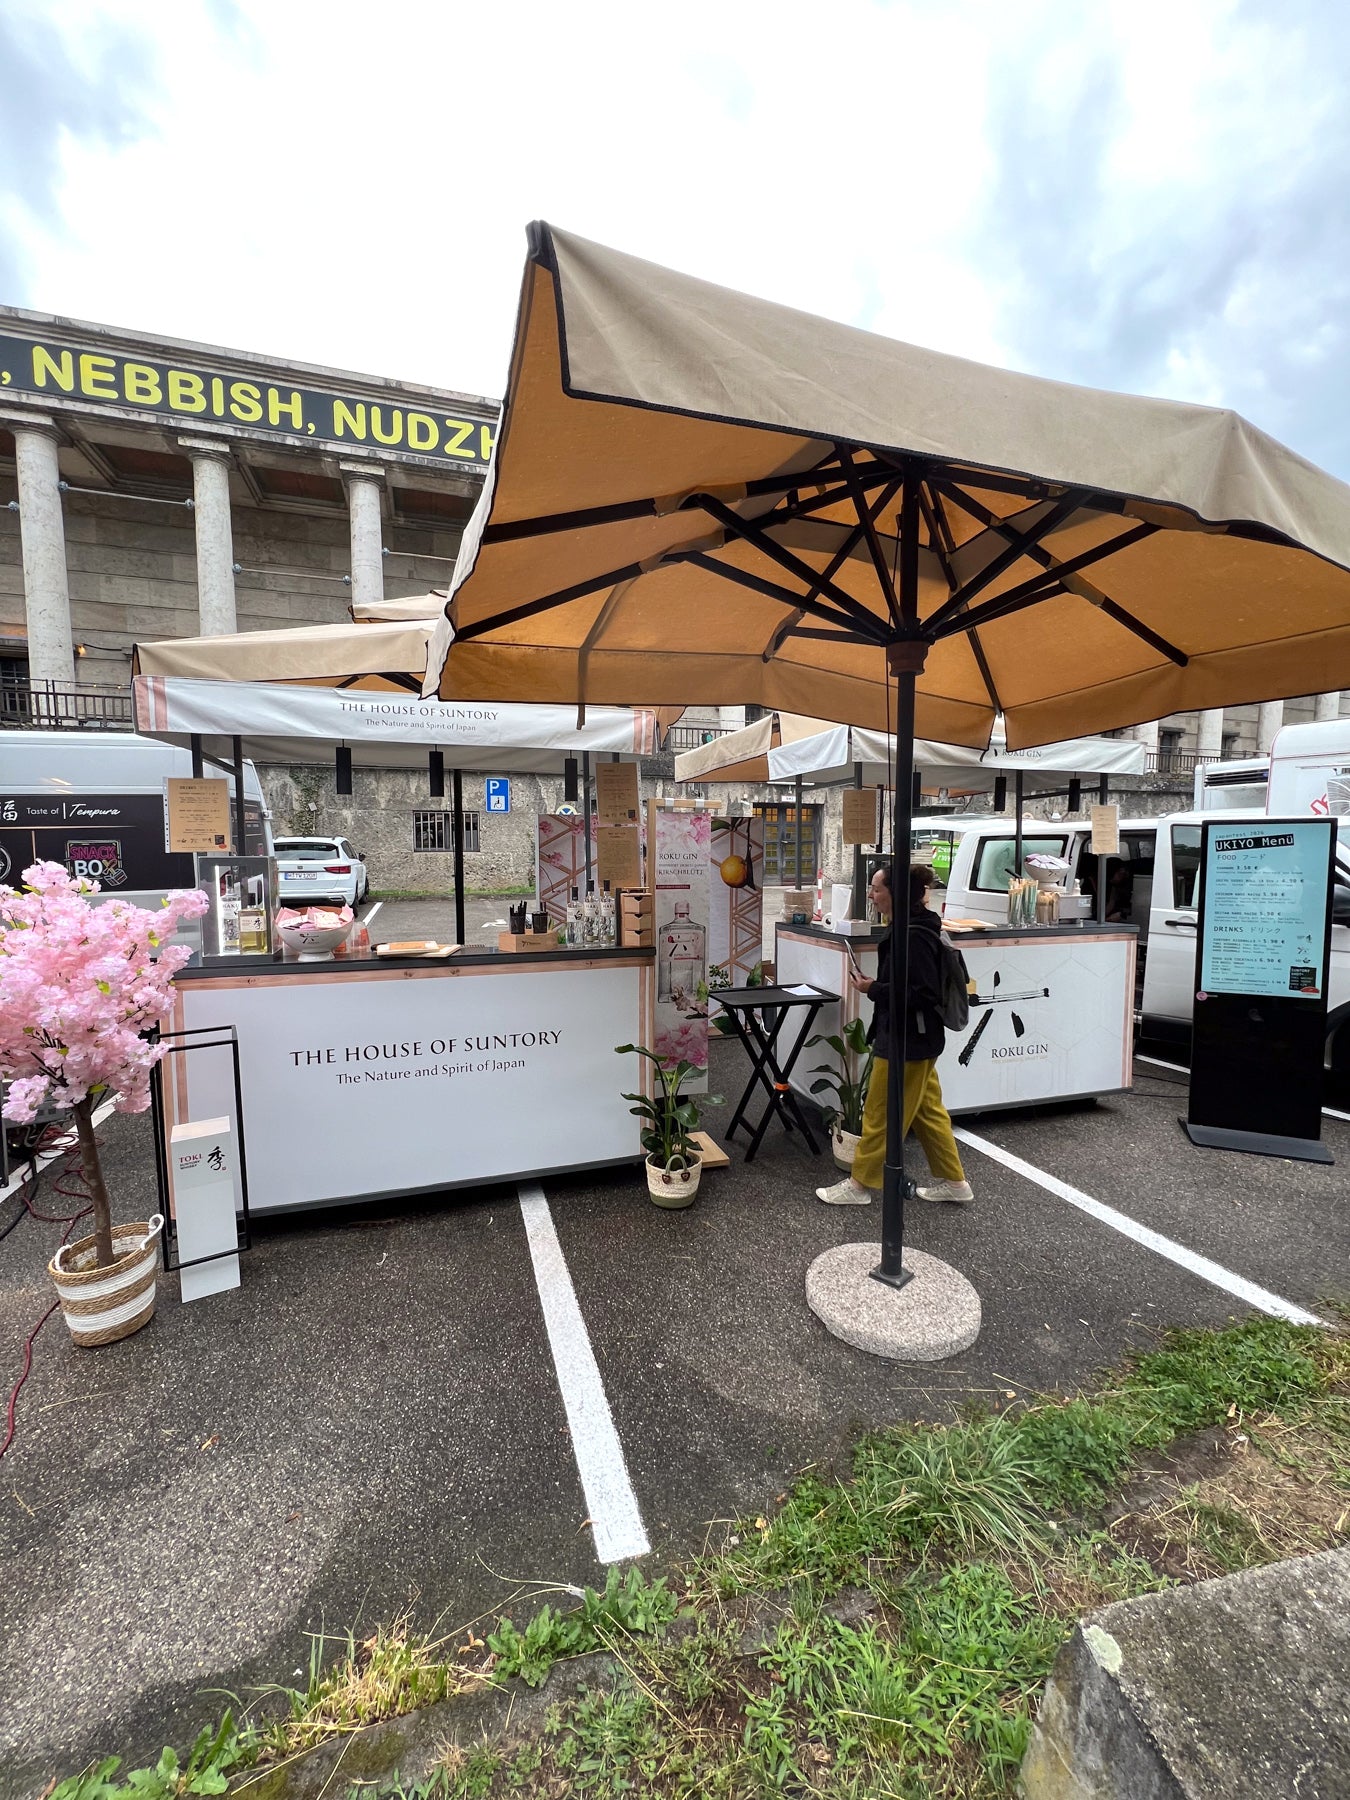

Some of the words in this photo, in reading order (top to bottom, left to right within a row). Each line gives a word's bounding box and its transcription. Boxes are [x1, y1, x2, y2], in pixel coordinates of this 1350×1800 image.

[32, 345, 316, 436] NEBBISH,
[340, 702, 366, 712] THE
[371, 704, 415, 716] HOUSE
[420, 707, 436, 716] OF
[440, 708, 498, 720] SUNTORY
[382, 720, 408, 728] Nature
[426, 722, 445, 730] Spirit
[490, 780, 500, 794] P
[69, 803, 121, 818] Tempura
[1216, 839, 1254, 850] UKIYO
[1262, 836, 1293, 846] Menü
[70, 846, 116, 860] SNACK
[290, 1048, 336, 1066] THE
[346, 1042, 423, 1062] HOUSE
[430, 1038, 458, 1055] OF
[464, 1030, 562, 1052] SUNTORY
[992, 1046, 1024, 1058] ROKU
[1027, 1044, 1048, 1055] GIN
[336, 1072, 360, 1084] The
[365, 1068, 411, 1082] Nature
[414, 1064, 438, 1078] and
[442, 1062, 474, 1077] Spirit
[478, 1059, 490, 1072] of
[492, 1058, 526, 1073] Japan
[179, 1153, 202, 1163] TOKI
